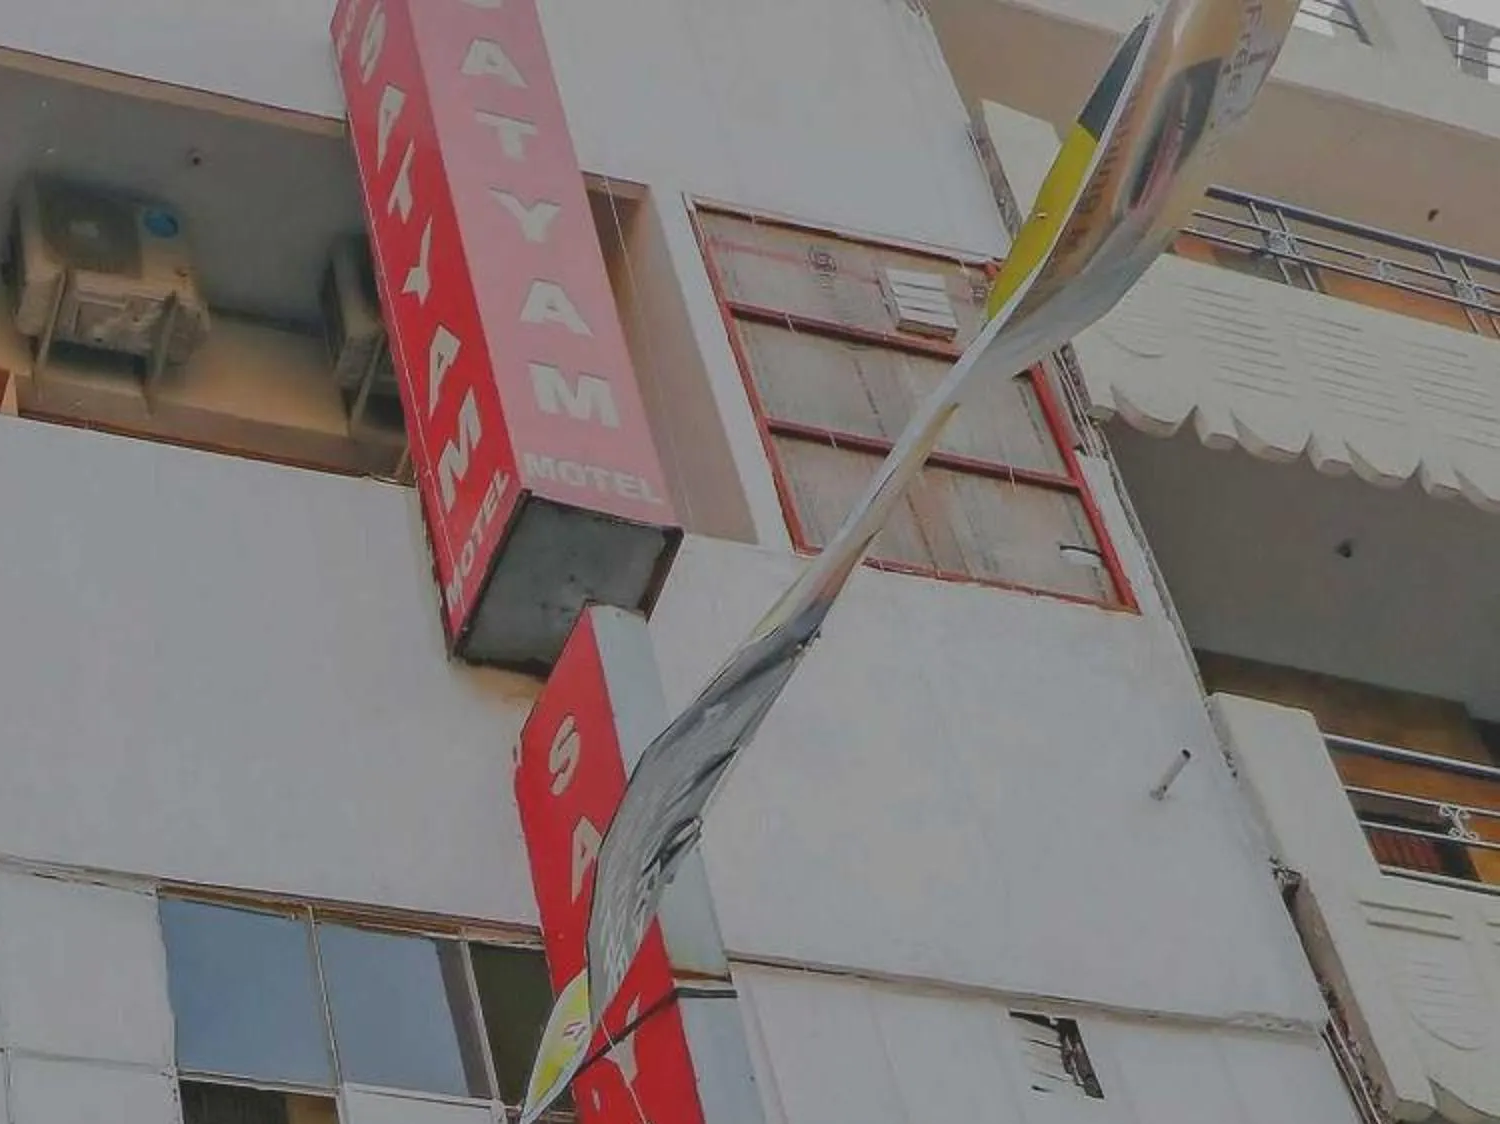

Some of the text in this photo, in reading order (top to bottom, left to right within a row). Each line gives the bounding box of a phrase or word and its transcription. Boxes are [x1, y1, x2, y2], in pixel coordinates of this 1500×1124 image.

[360, 0, 482, 509] SATYAM
[458, 0, 621, 428] ATYAM
[446, 468, 510, 612] MOTEL
[523, 454, 663, 505] MOTEL
